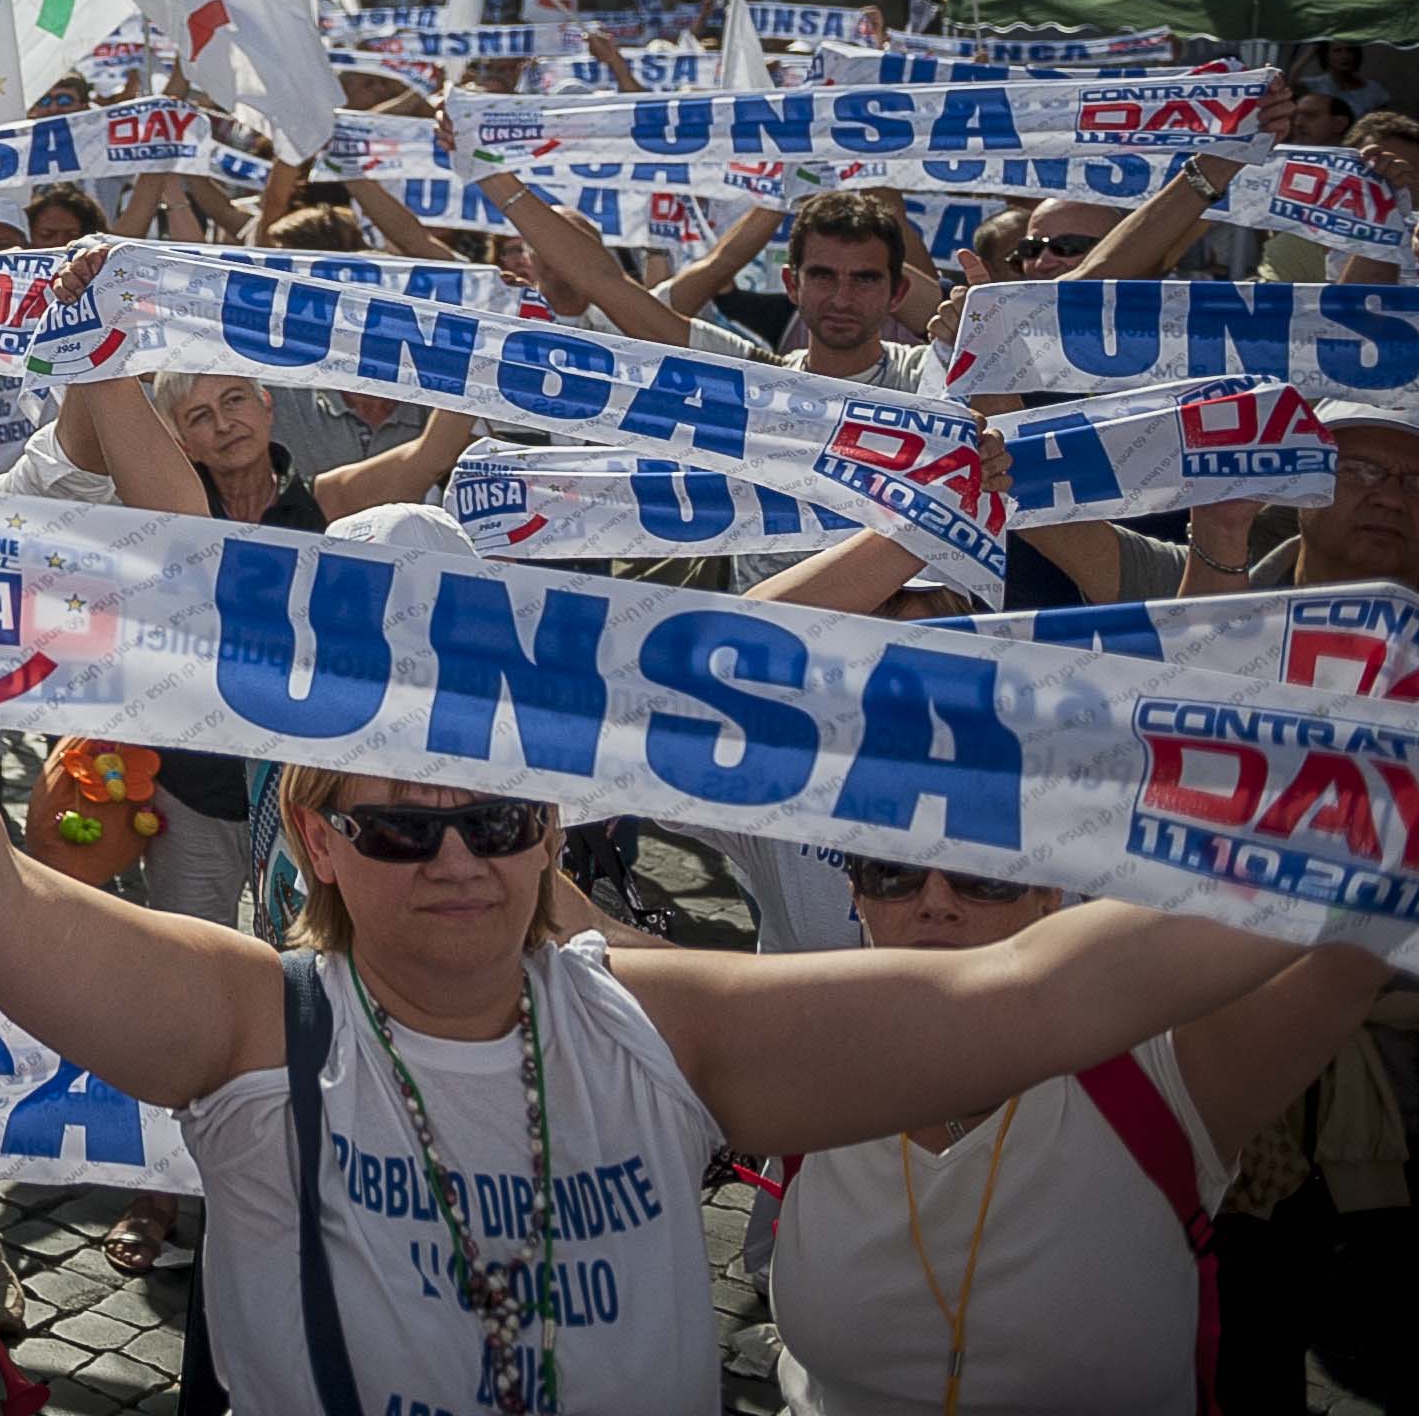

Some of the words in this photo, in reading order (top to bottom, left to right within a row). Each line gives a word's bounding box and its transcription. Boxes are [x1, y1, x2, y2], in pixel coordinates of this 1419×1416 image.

[755, 6, 846, 37] UNSA
[572, 55, 697, 83] USA
[1080, 99, 1259, 134] DAY
[1082, 86, 1262, 102] CONTRATTO
[108, 110, 198, 145] DAY
[631, 88, 1022, 155] UNSA
[1077, 132, 1219, 147] 11.10.20
[405, 177, 621, 237] UNA
[1278, 161, 1397, 225] DAY
[1271, 200, 1400, 243] 11.10.2014
[1058, 281, 1419, 390] UNS
[222, 270, 749, 460] UNSA
[846, 400, 981, 445] CONTR
[1179, 385, 1339, 449] DA
[1185, 449, 1339, 477] 11.10.2
[460, 482, 524, 515] UNSA
[215, 538, 1023, 852] UNSA
[1138, 701, 1419, 762] CONTRAT
[1136, 817, 1419, 919] 11.10.201
